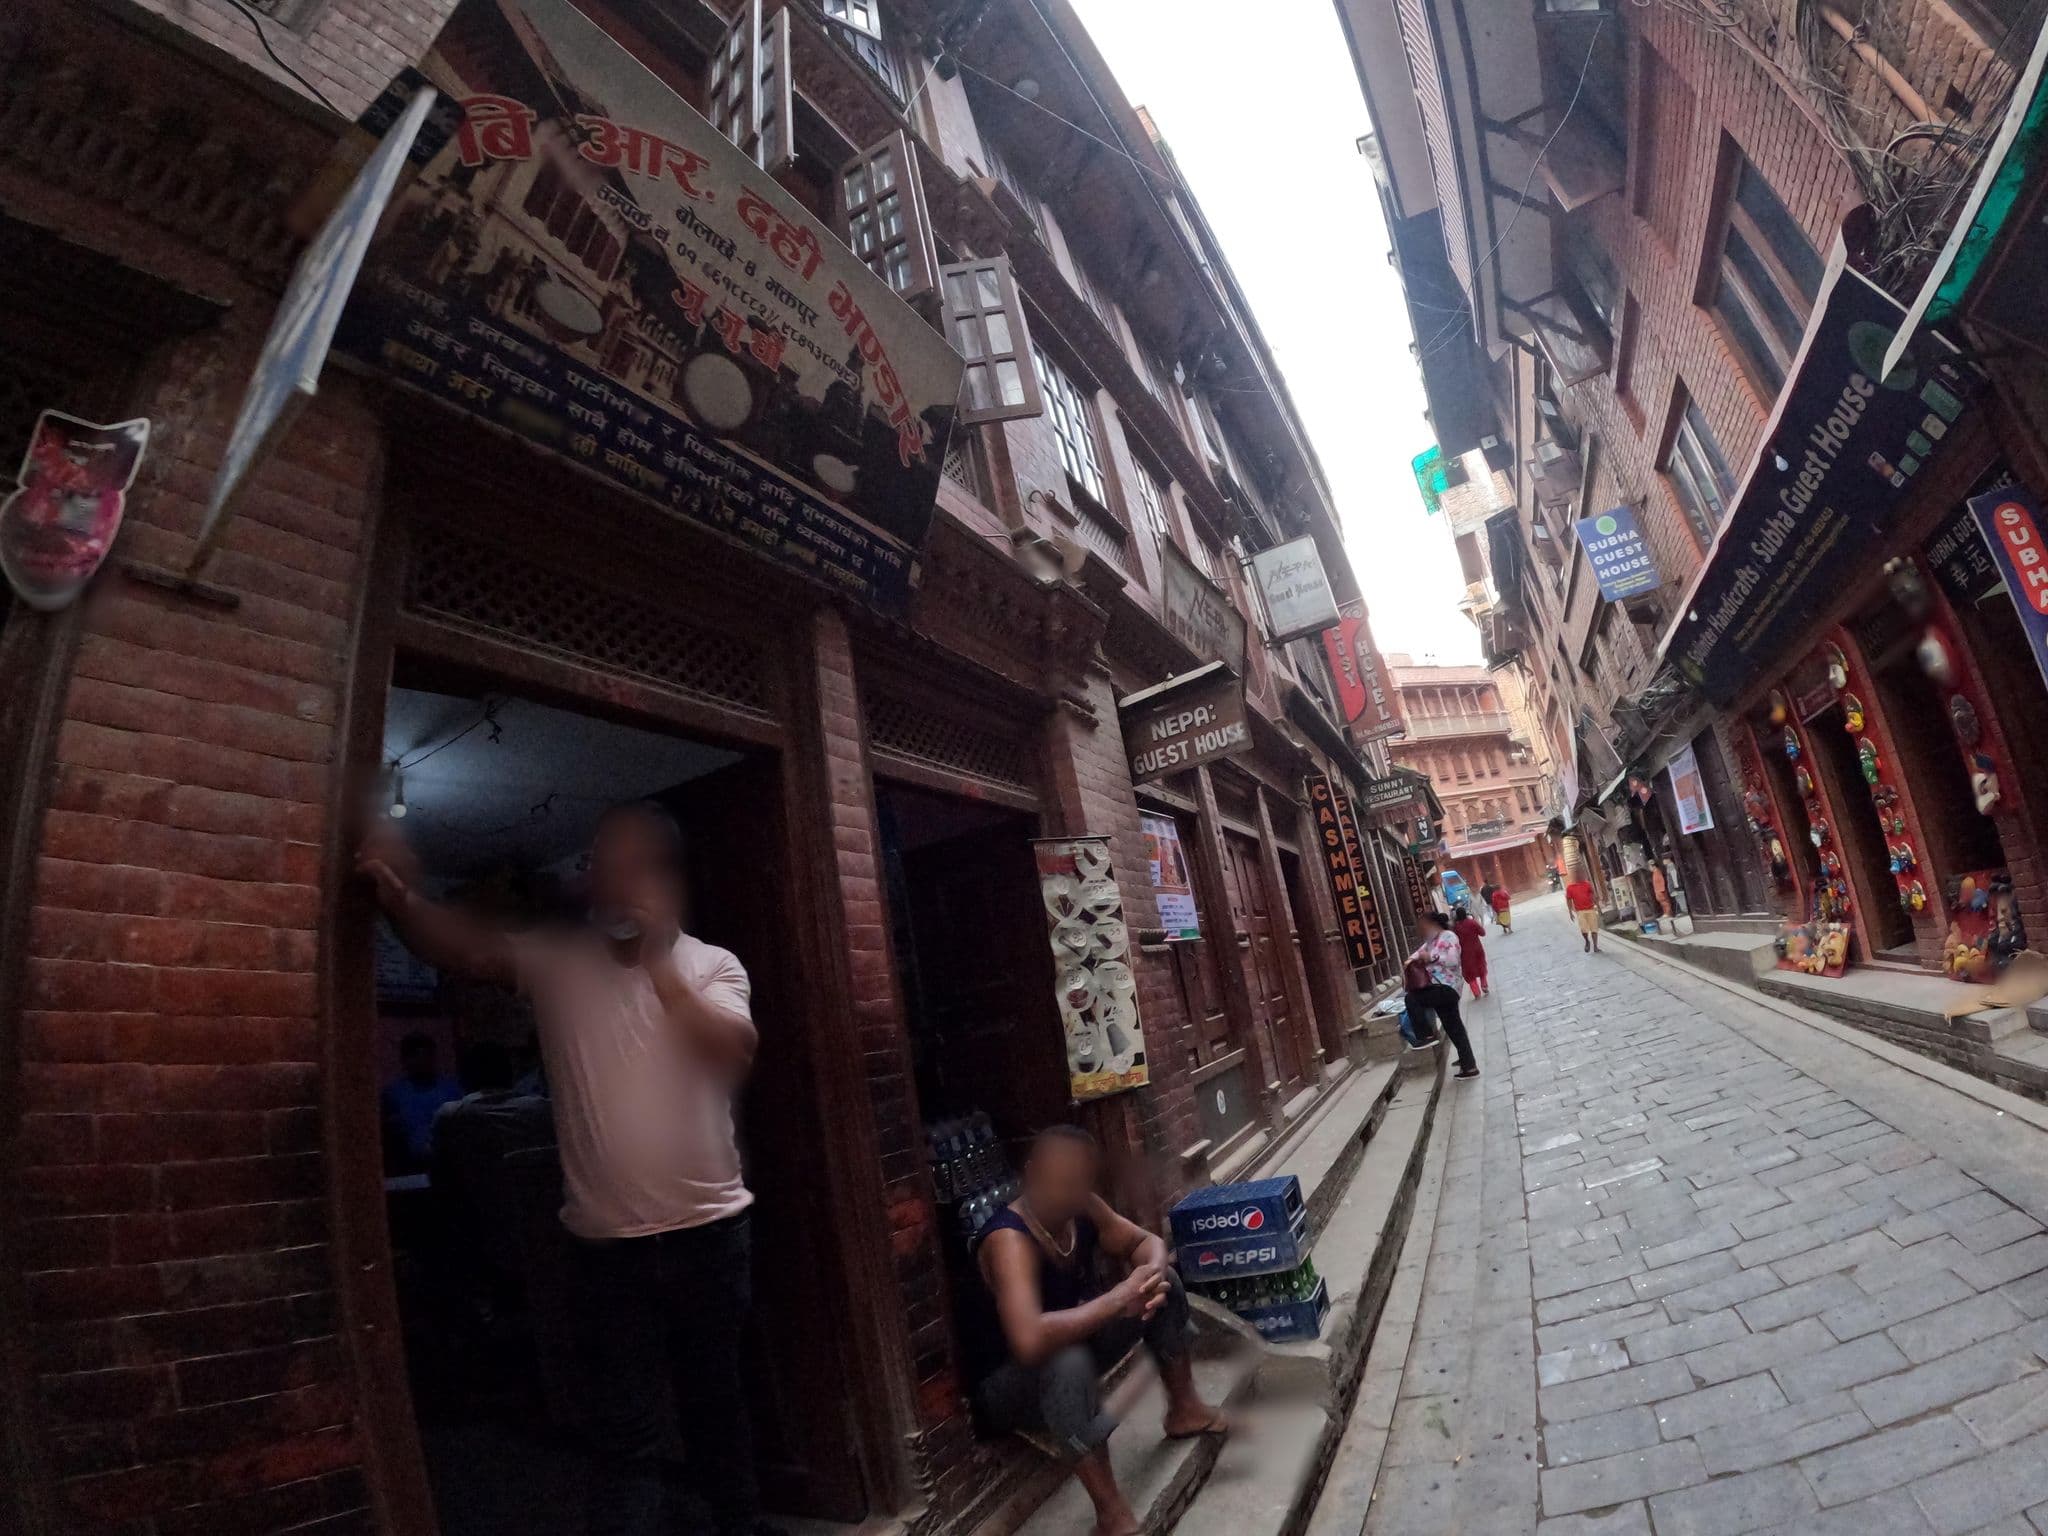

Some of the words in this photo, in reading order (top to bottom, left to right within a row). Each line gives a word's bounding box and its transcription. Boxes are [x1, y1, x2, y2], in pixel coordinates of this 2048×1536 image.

[737, 183, 826, 281] दही
[827, 279, 929, 469] भण्डार
[1709, 562, 1762, 635] Handicrafts
[1750, 502, 1797, 566] Subha
[1779, 452, 1831, 518] Guest
[1808, 371, 1876, 466] House
[1587, 529, 1640, 553] SUBHA
[1593, 541, 1644, 566] GUEST
[1599, 555, 1651, 580] HOUSE
[1356, 638, 1391, 722] HOTEL
[1132, 738, 1191, 777] GUEST
[1193, 718, 1248, 756] HOUSE
[1370, 777, 1405, 795] SUNNY
[1311, 782, 1366, 960] CASHMERI
[1334, 797, 1365, 884] CARPET
[1357, 884, 1371, 898] &
[1221, 1246, 1276, 1267] PEPSI
